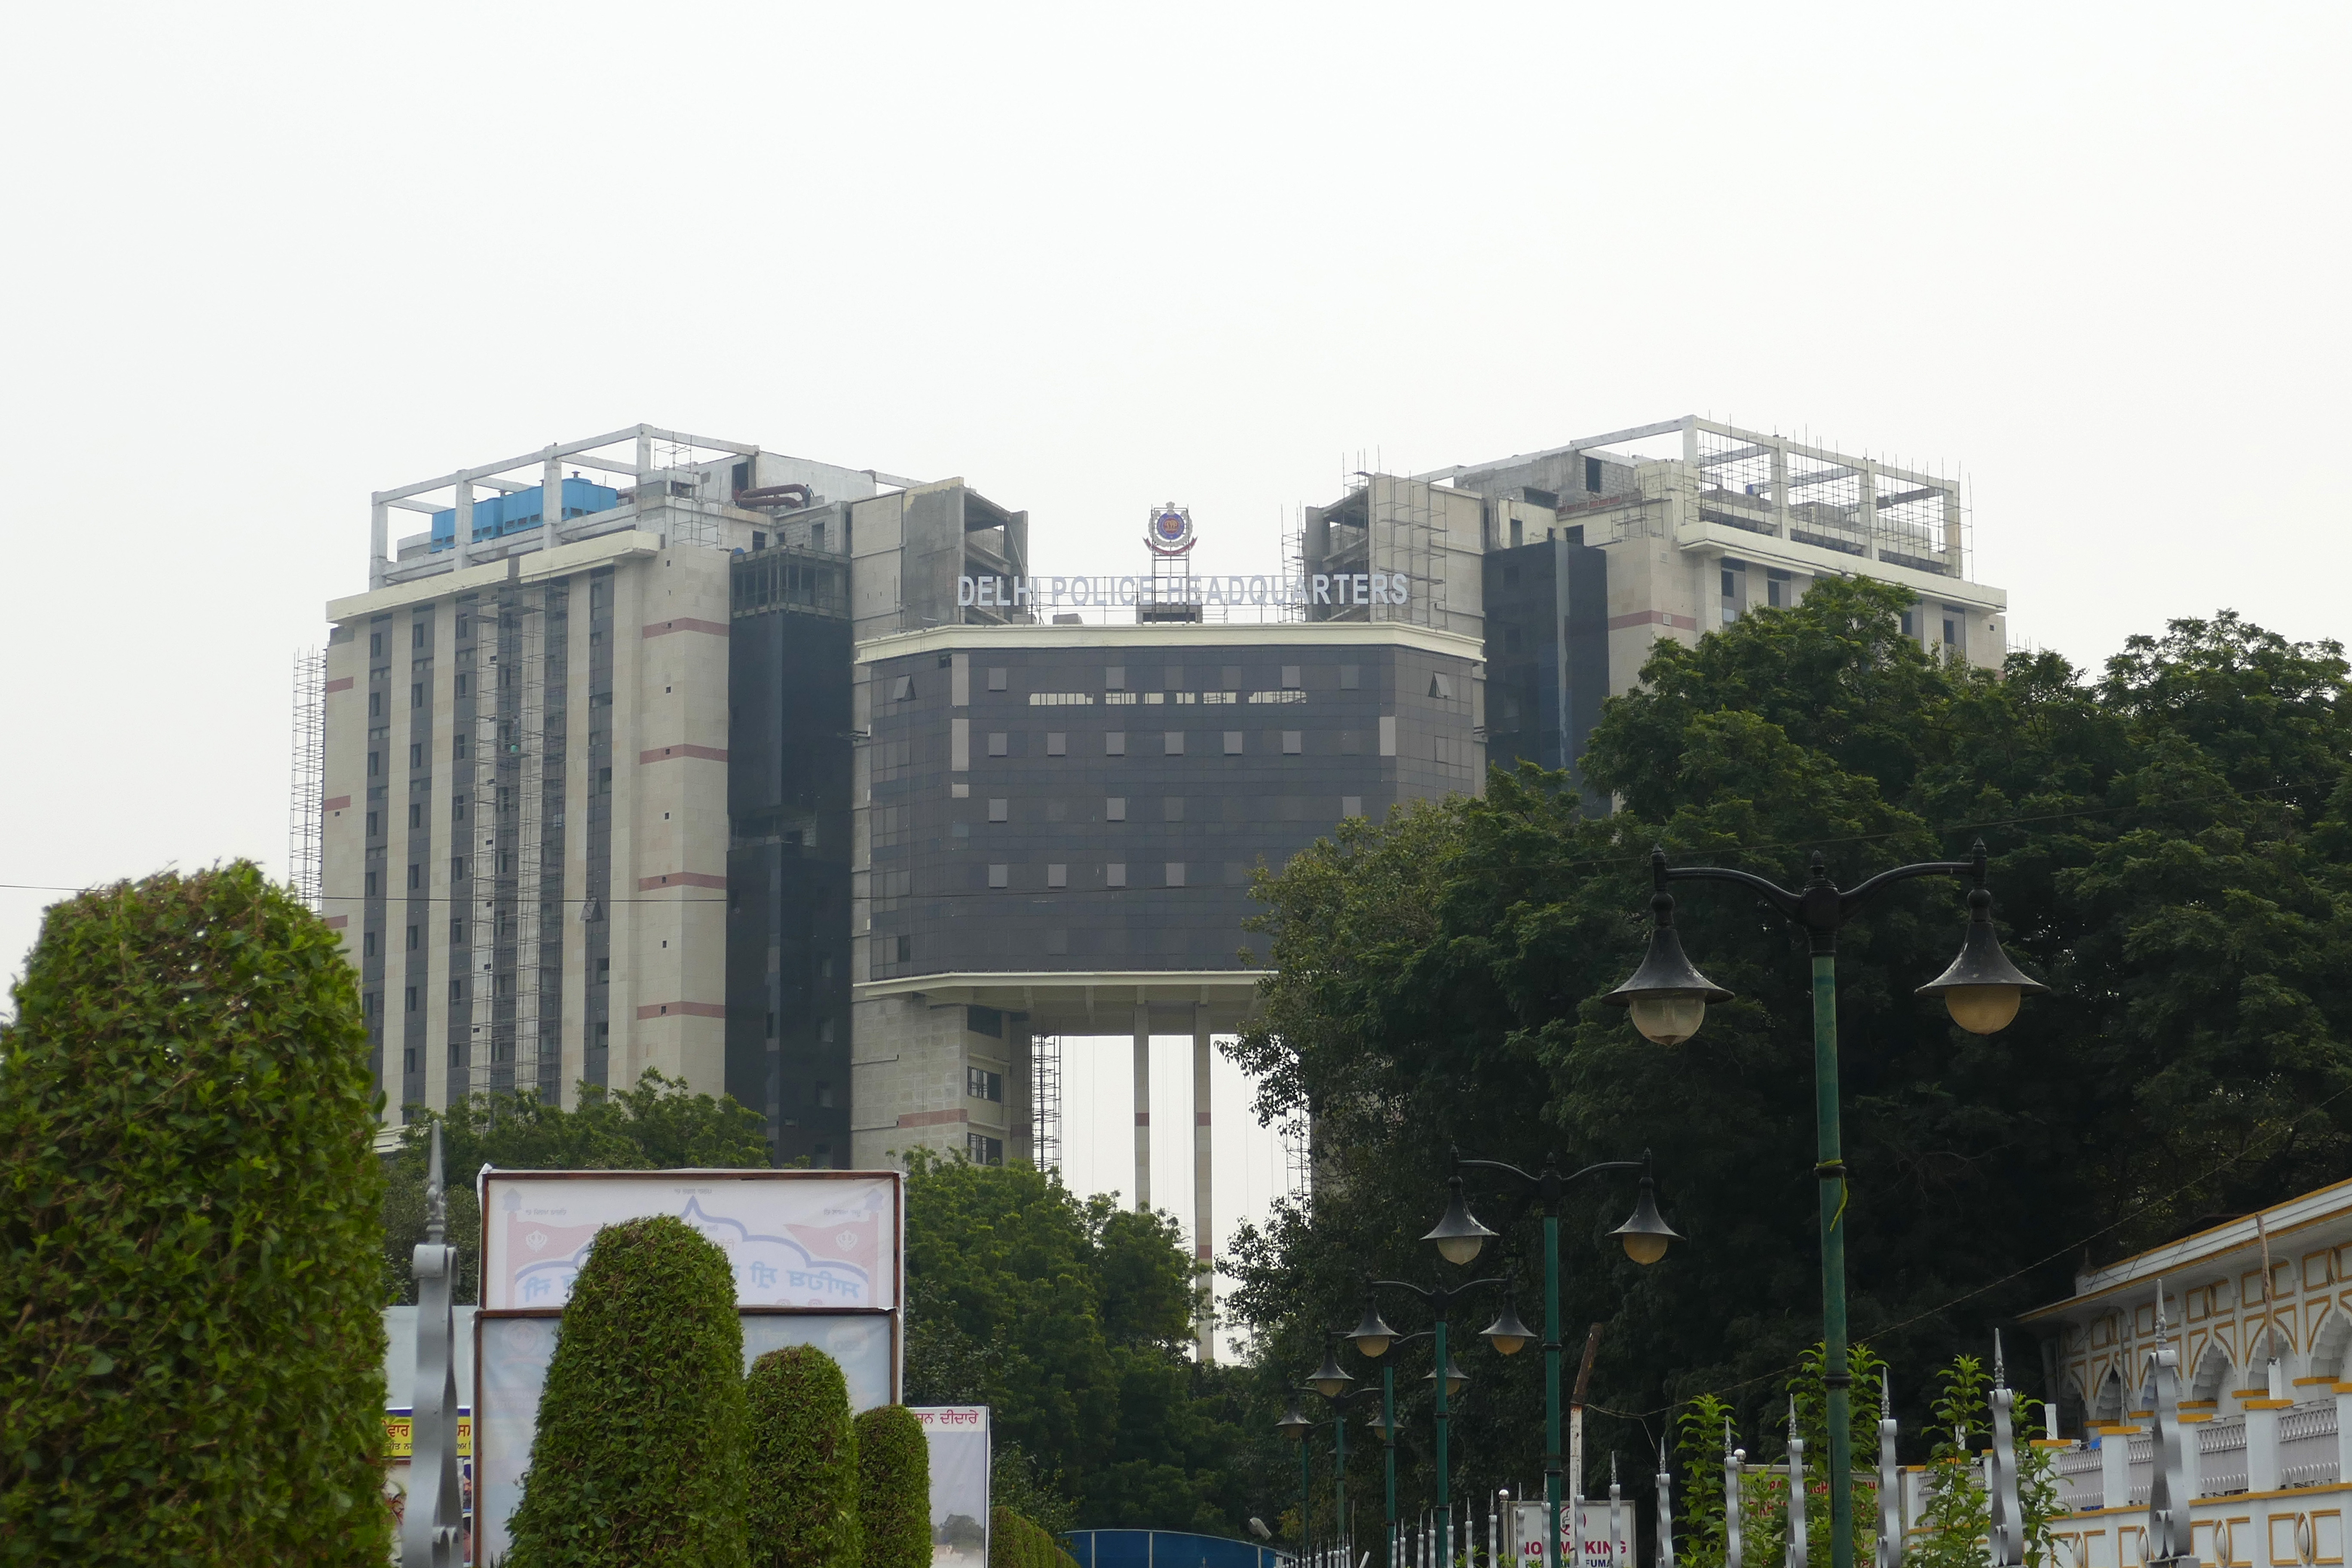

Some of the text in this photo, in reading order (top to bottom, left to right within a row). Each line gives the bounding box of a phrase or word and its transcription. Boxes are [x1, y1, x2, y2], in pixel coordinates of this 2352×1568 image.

[958, 573, 1408, 606] DELHI POLICE HEADQUARTERS
[940, 1409, 979, 1424] ਦੀਦਾਰੇ
[1560, 1540, 1627, 1554] MKING
